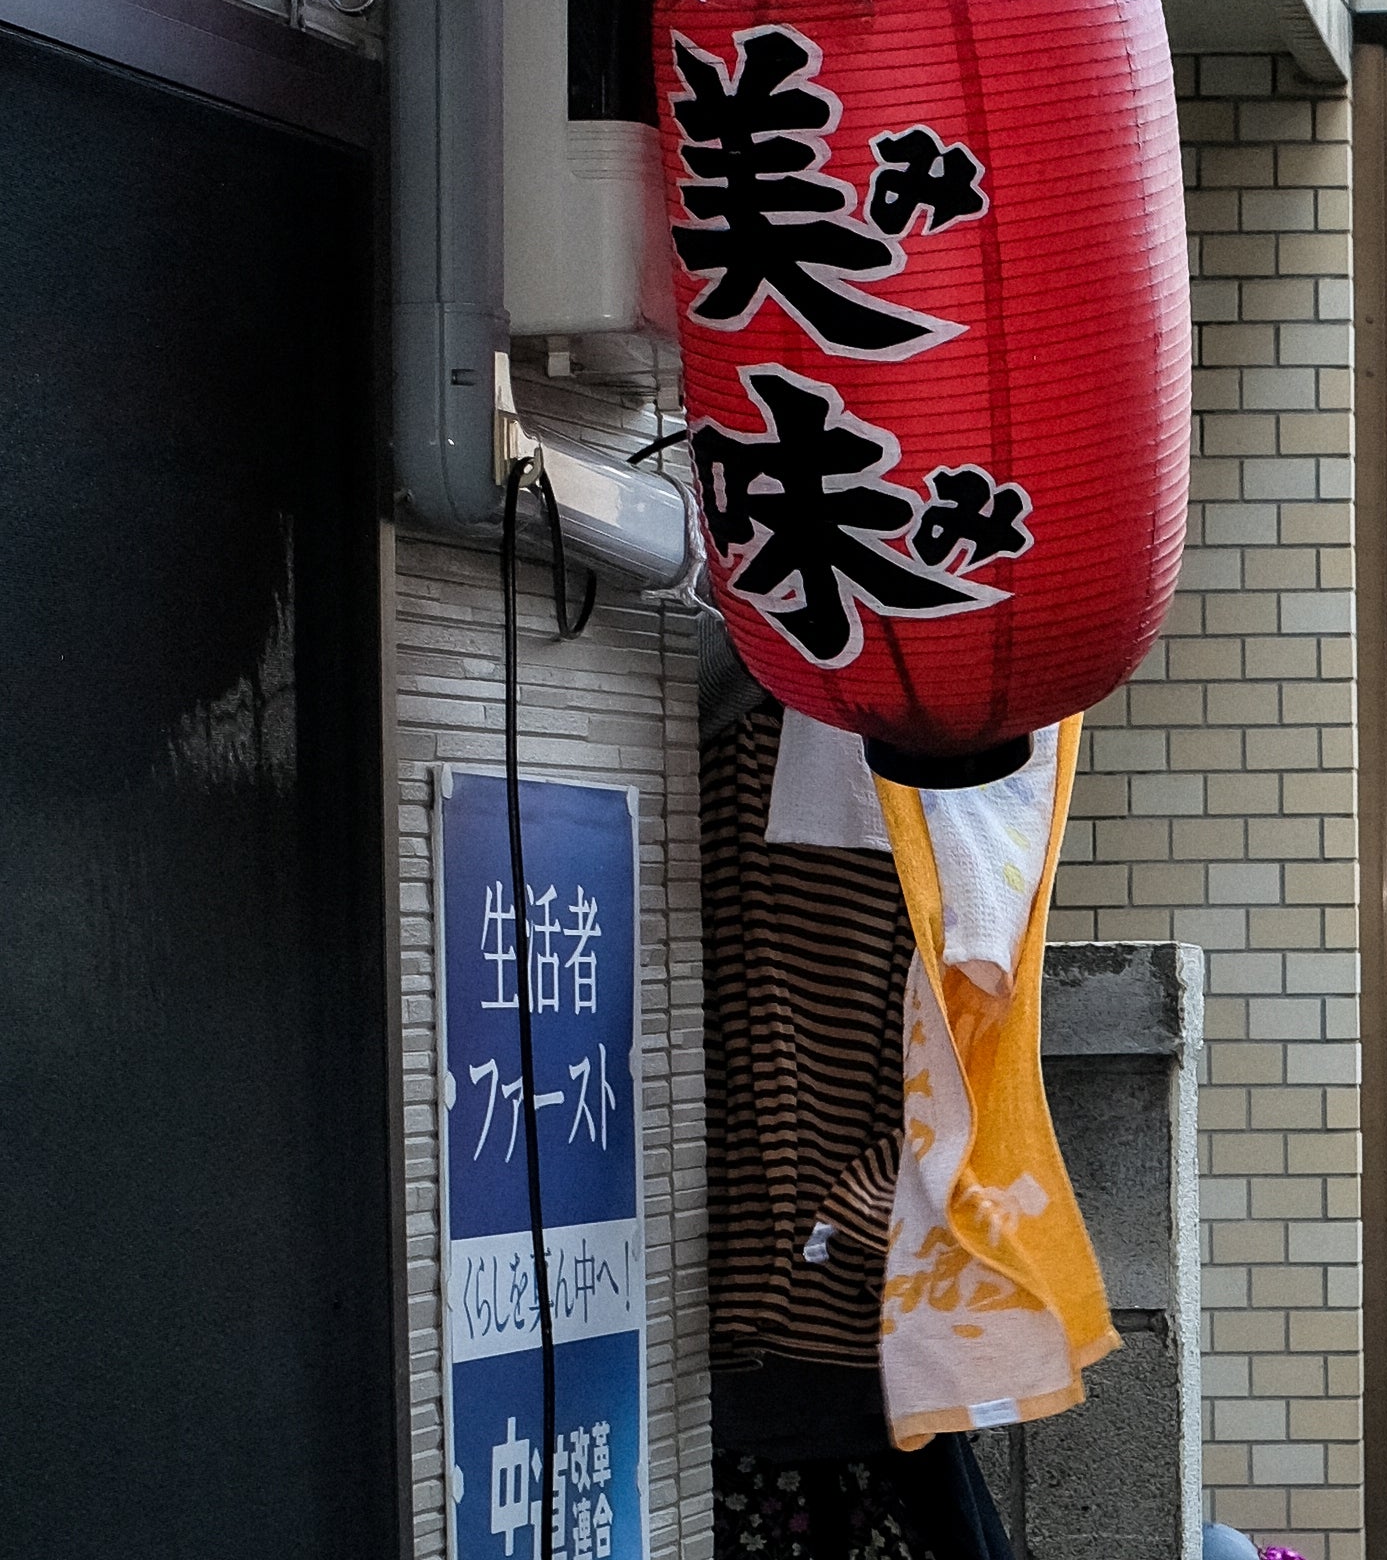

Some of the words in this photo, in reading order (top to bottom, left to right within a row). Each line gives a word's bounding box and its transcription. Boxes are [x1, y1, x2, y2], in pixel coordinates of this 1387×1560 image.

[668, 23, 1015, 669] 美味
[480, 880, 602, 1016] 生活者
[468, 1042, 616, 1164] ファースト
[570, 1420, 612, 1493] 改革
